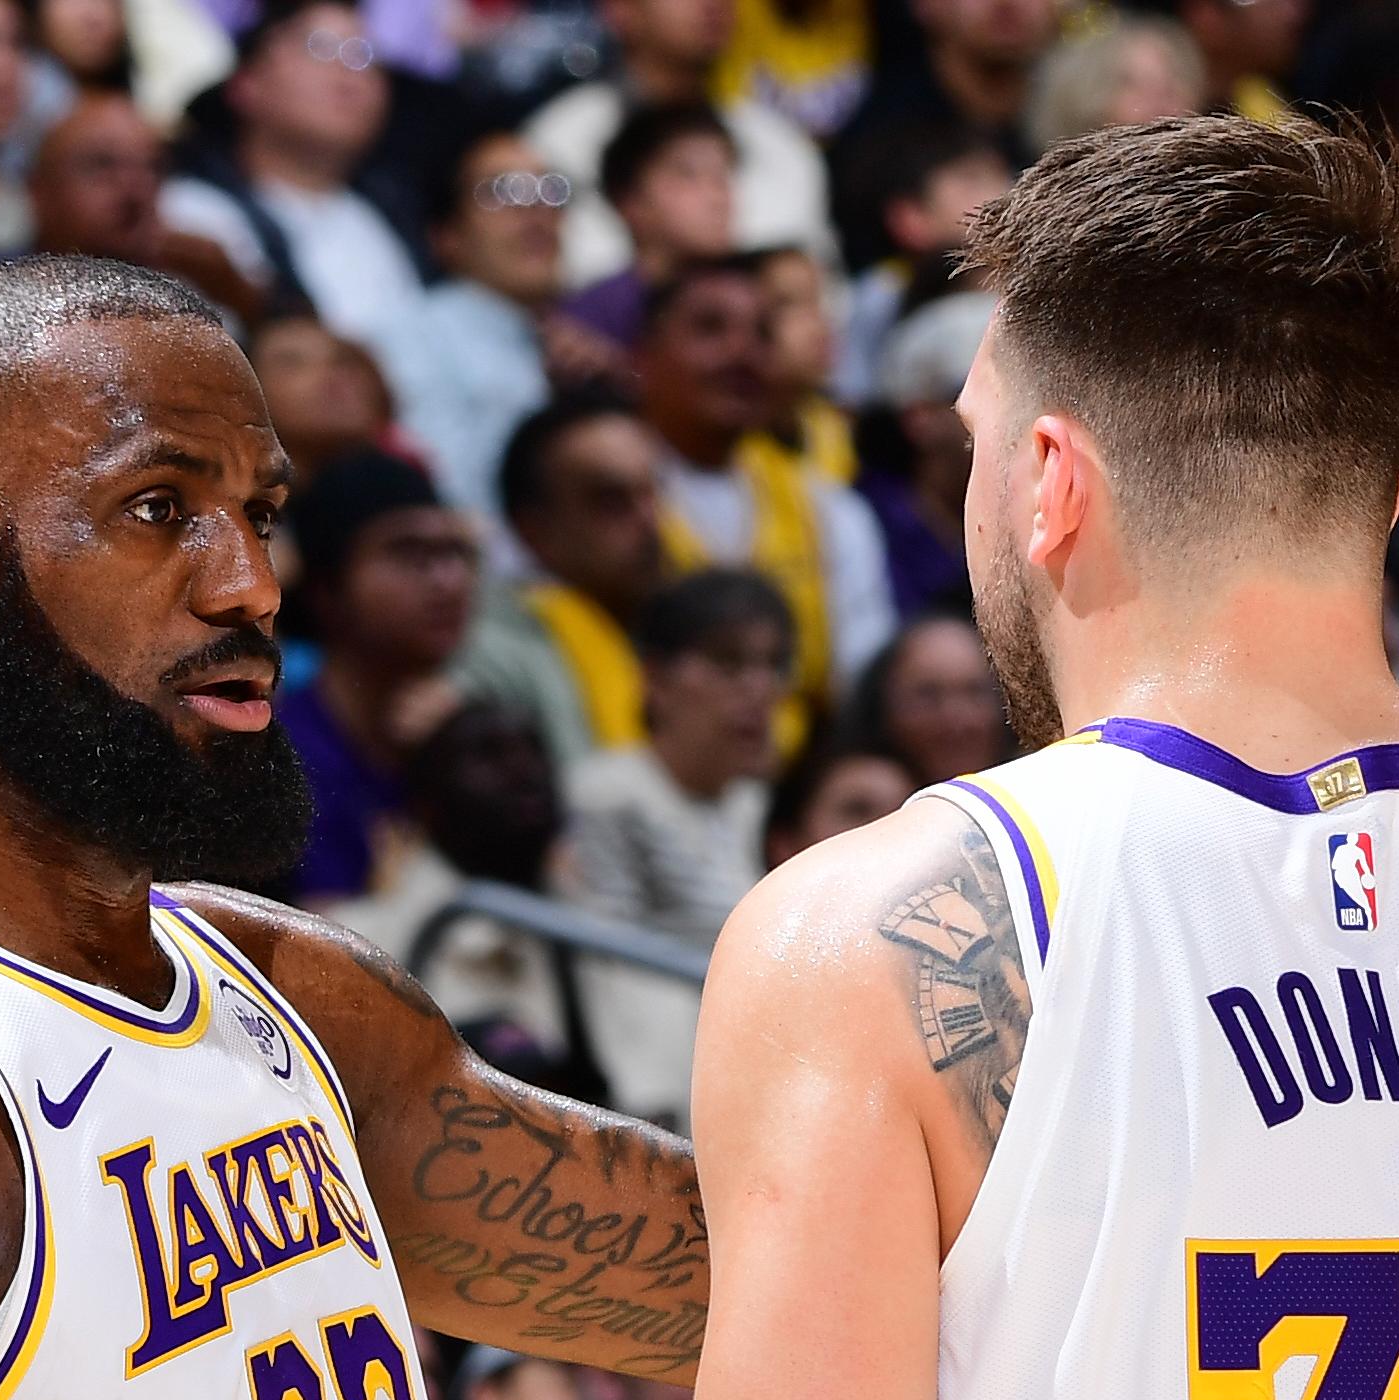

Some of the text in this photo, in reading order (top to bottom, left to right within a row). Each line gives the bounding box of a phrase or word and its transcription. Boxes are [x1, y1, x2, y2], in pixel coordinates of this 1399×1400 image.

[1340, 908, 1364, 926] NBA
[97, 1115, 382, 1380] LAKERS
[412, 1086, 648, 1265] Echoes
